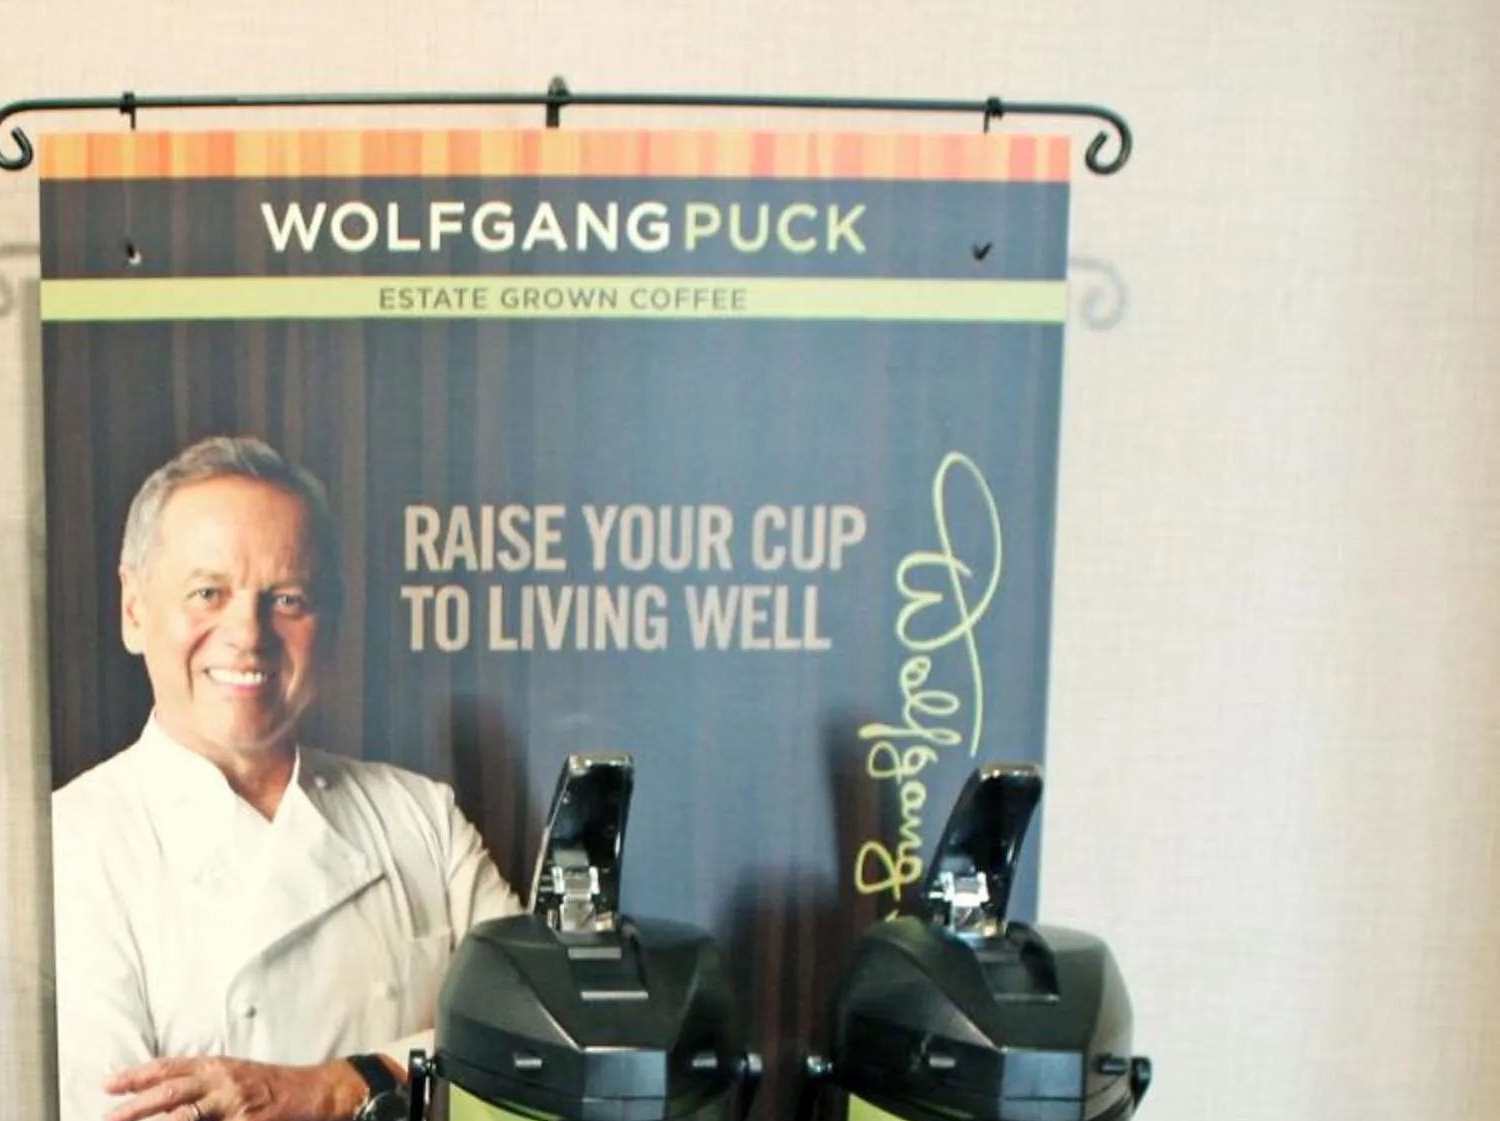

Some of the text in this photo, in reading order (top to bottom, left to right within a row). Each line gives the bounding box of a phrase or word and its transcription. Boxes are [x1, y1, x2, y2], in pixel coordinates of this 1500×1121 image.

[379, 287, 748, 310] ESTATE GROWN COFFEE
[404, 504, 867, 572] RAISE YOUR CUP
[400, 584, 832, 651] TO LIVING WELL
